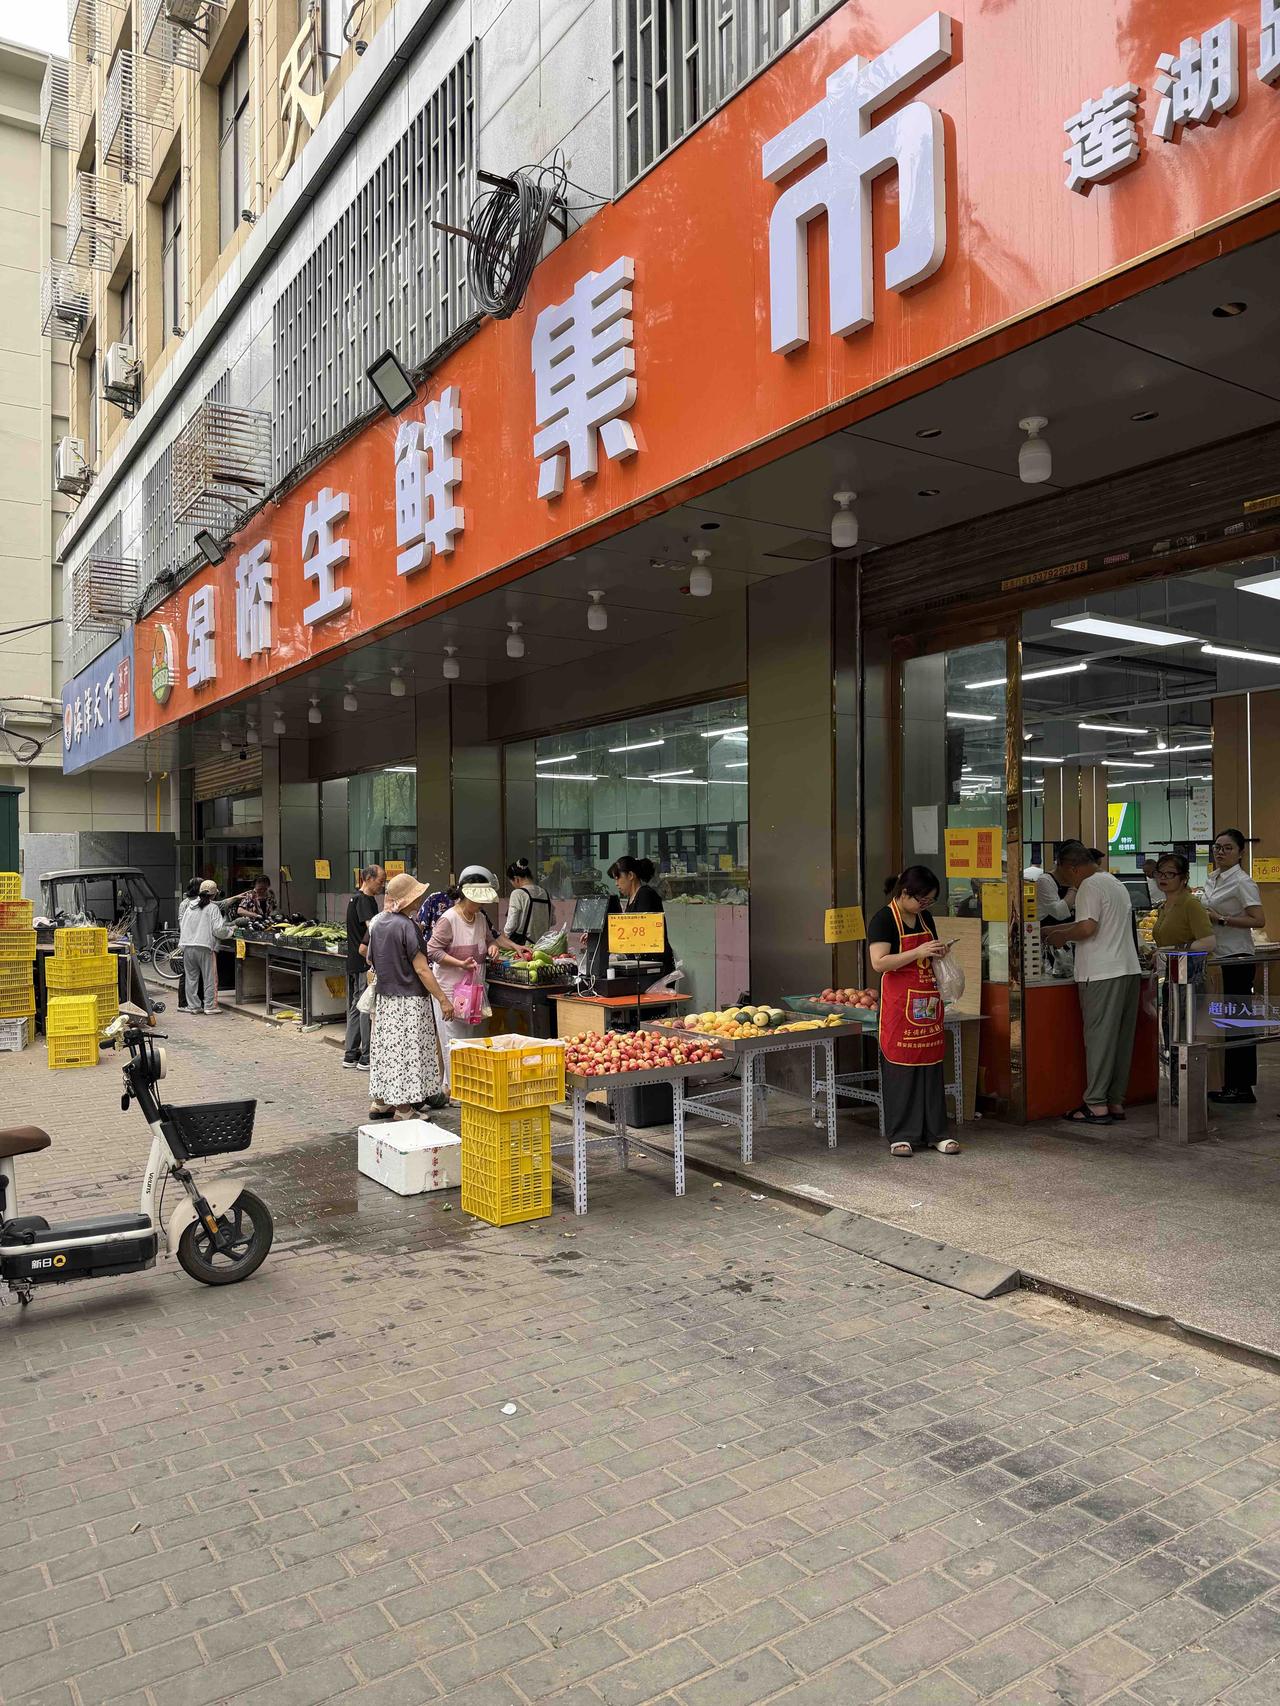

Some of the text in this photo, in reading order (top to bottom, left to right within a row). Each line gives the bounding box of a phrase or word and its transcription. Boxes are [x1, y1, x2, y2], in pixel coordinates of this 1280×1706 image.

[1064, 0, 1280, 196] 莲湖
[617, 926, 646, 940] 2.98
[31, 1257, 53, 1270] 新日
